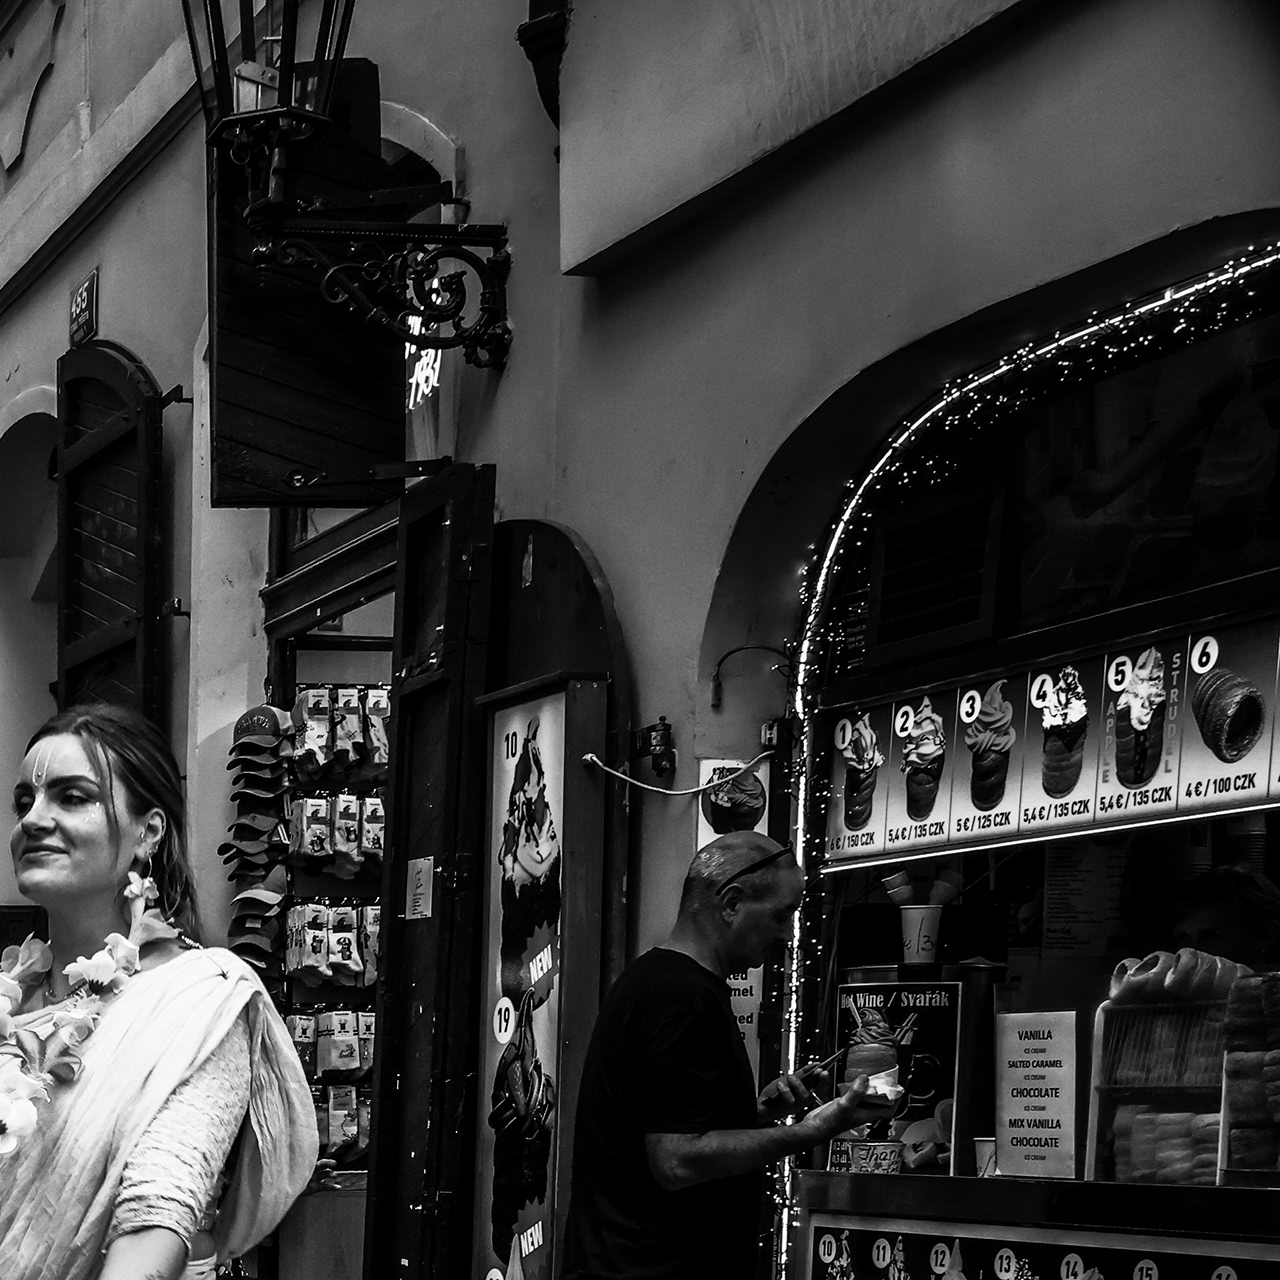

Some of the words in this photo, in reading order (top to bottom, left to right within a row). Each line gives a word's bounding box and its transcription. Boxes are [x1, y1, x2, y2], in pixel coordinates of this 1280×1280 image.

[1198, 642, 1210, 668] 6
[1114, 661, 1126, 686] 5
[1036, 678, 1047, 702] 4
[966, 695, 976, 718] 3
[900, 710, 909, 732] 2
[840, 725, 847, 744] 1
[504, 732, 517, 759] 10
[1185, 783, 1191, 798] 4
[1212, 778, 1231, 794] 100
[1233, 773, 1256, 791] CZK
[1100, 795, 1114, 812] 5,4
[1132, 790, 1149, 806] 135
[1151, 786, 1171, 802] CZK
[1023, 807, 1036, 824] 5,4
[1053, 803, 1069, 818] 135
[1071, 799, 1090, 814] CZK
[889, 828, 900, 842] 5,4
[913, 824, 927, 838] 135
[929, 822, 945, 835] CZK
[957, 818, 962, 832] 5
[978, 815, 992, 829] 125
[993, 812, 1011, 826] CZK
[847, 834, 859, 848] 150
[860, 832, 875, 845] CZK
[529, 943, 553, 985] NEW
[856, 992, 885, 1008] Wine
[901, 990, 949, 1007] Svařák
[497, 1008, 510, 1032] 19
[1017, 1030, 1052, 1041] VANILLA
[1007, 1060, 1031, 1068] SALTED
[1031, 1060, 1063, 1068] CARAMEL
[1011, 1087, 1060, 1098] CHOCOLATE
[1008, 1118, 1025, 1129] MIX
[1026, 1118, 1062, 1129] VANILLA
[1010, 1137, 1060, 1148] CHOCOLATE
[521, 1220, 544, 1258] NEW
[822, 1241, 833, 1257] 10
[875, 1245, 886, 1262] 11
[933, 1250, 945, 1268] 12
[998, 1254, 1011, 1273] 13
[1065, 1260, 1079, 1280] 14
